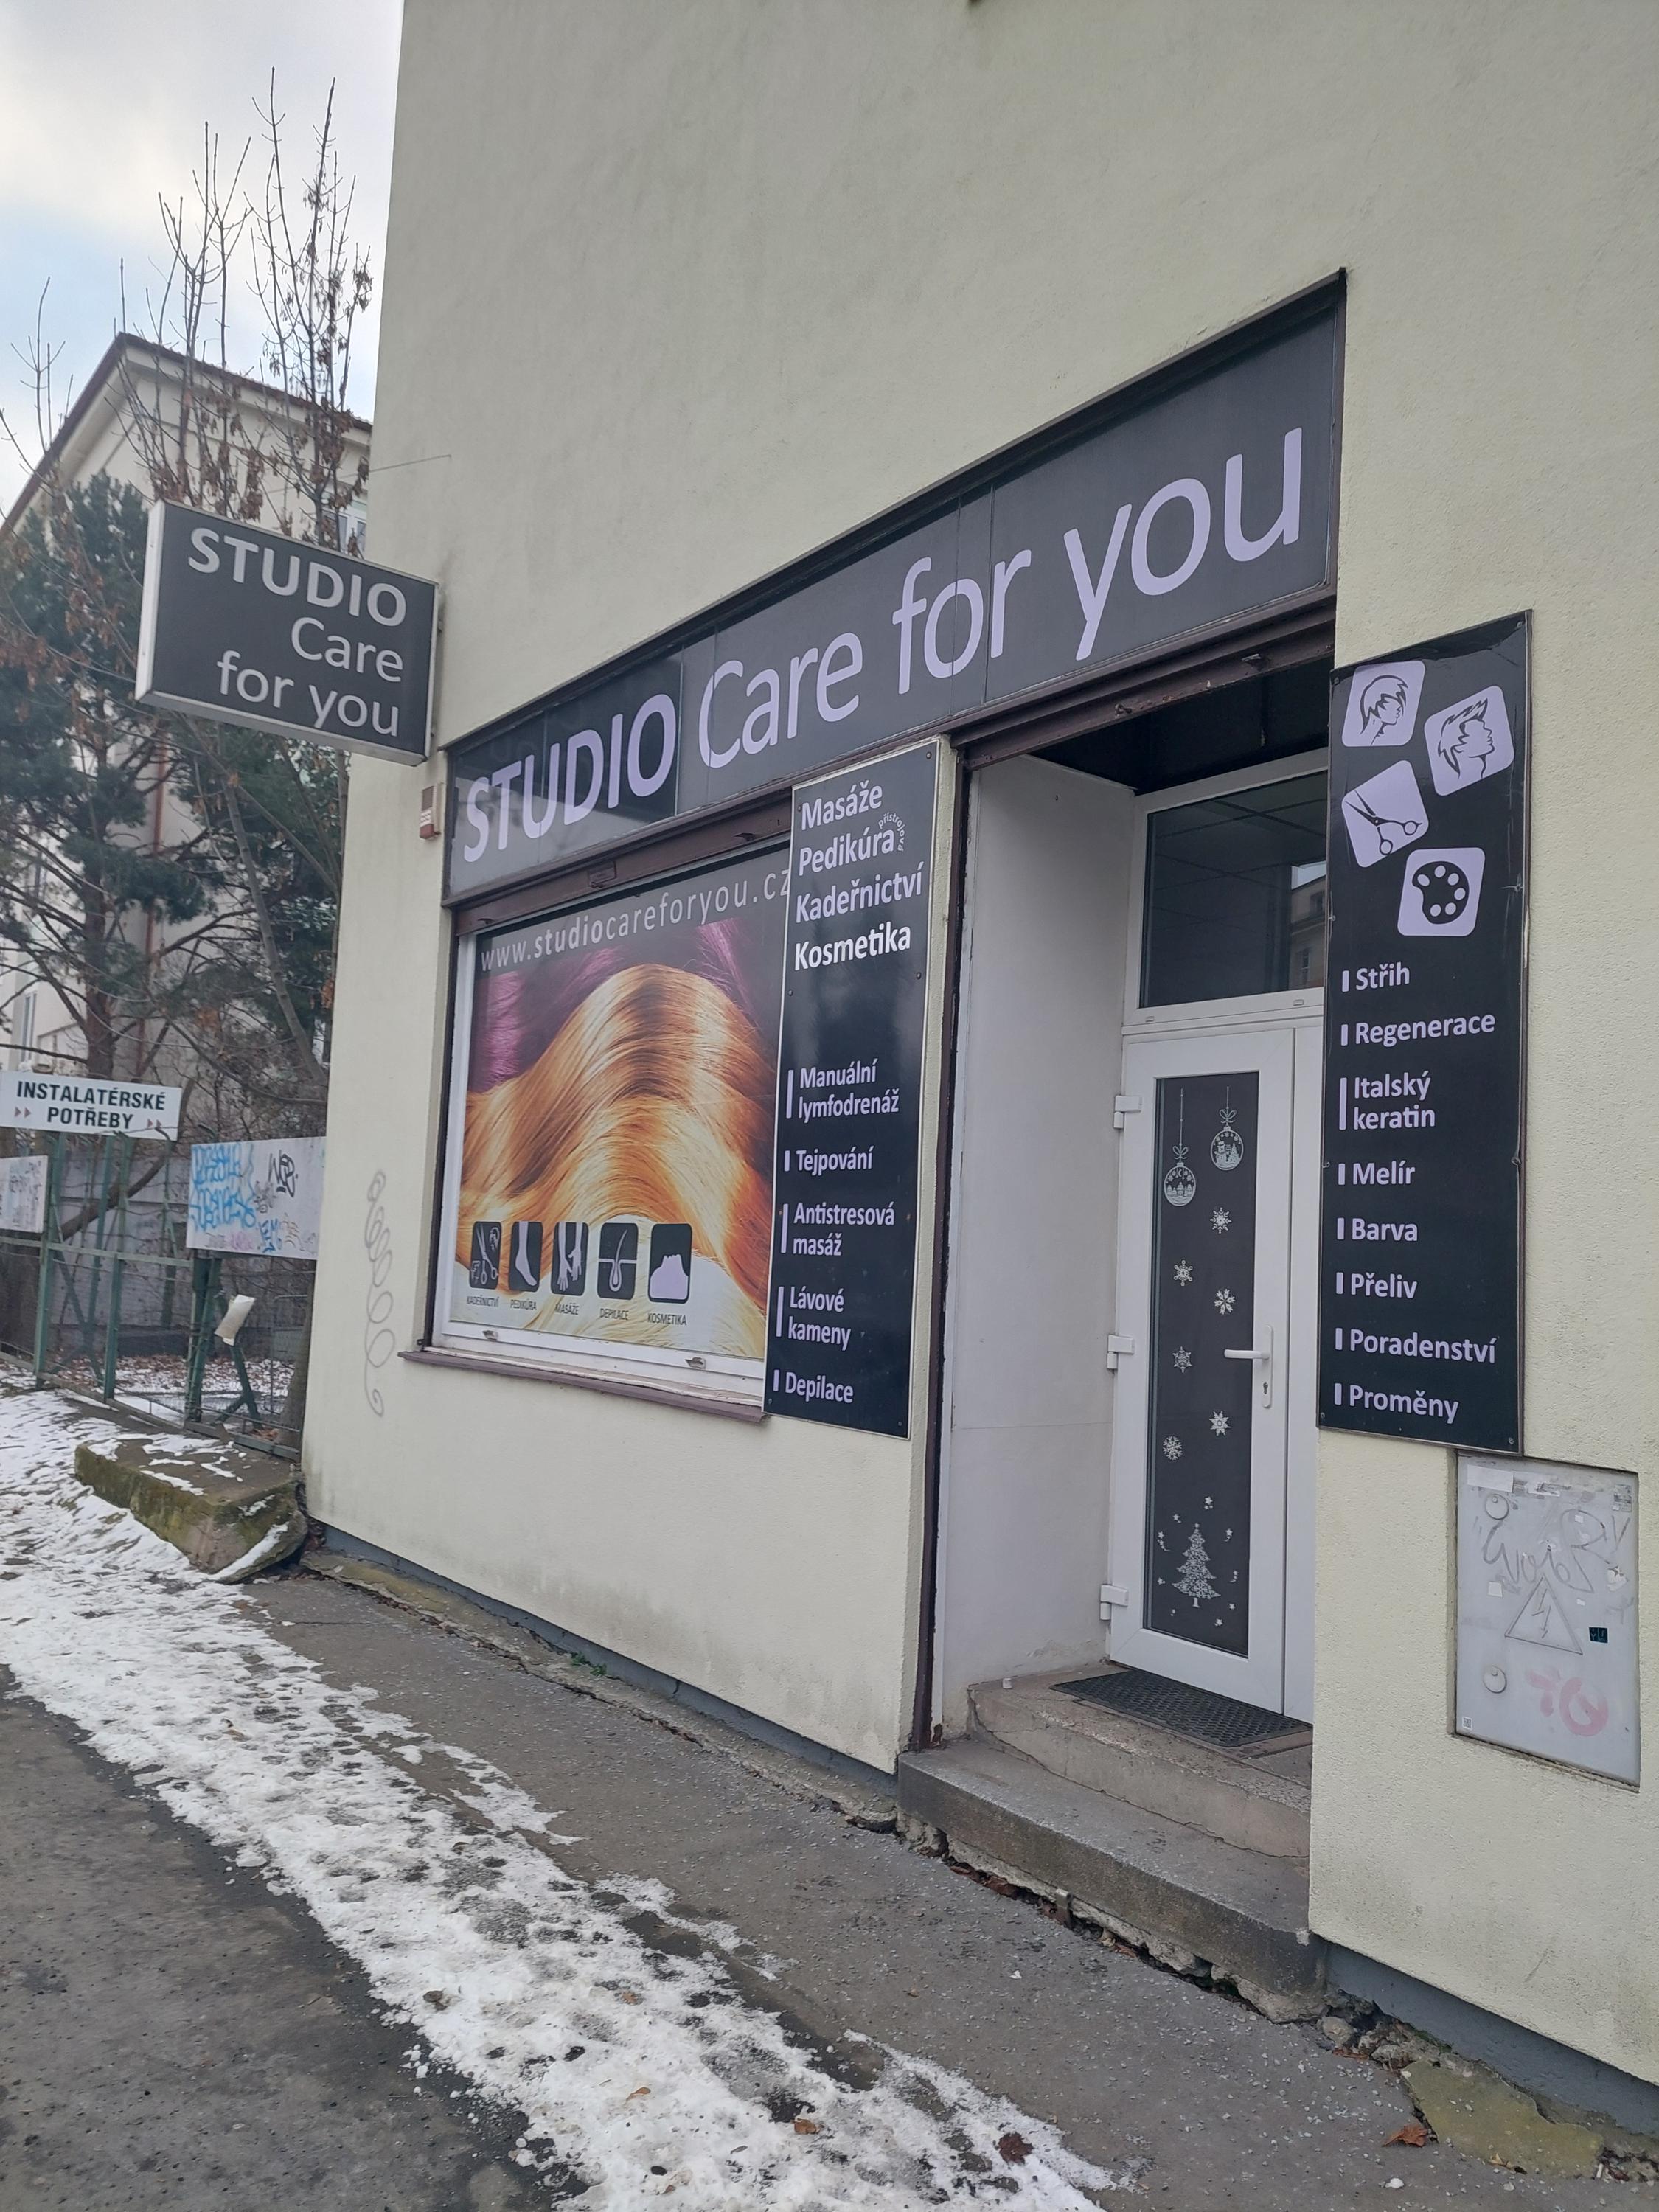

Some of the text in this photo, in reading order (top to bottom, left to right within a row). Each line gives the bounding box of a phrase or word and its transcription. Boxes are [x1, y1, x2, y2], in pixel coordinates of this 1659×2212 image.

[188, 528, 407, 627] STUDIO
[291, 616, 403, 682] Care
[464, 427, 1302, 863] STUDIO Care for you
[217, 650, 399, 736] for you
[801, 780, 883, 831] Masáže
[799, 827, 894, 876] Pedikúra
[796, 861, 924, 923] Kadeřnictví
[481, 869, 790, 972] www.studiocareforyou.cz
[794, 921, 911, 971] Kosmetika
[1355, 961, 1410, 991] Střih
[1355, 1014, 1495, 1047] Regenerace
[800, 1057, 878, 1089] Manuální
[1354, 1071, 1431, 1101] Italský
[17, 1081, 166, 1110] INSTALATÉRSKÉ
[798, 1088, 900, 1124] lymfodrenáž
[46, 1105, 133, 1130] POTŘEBY
[1353, 1105, 1436, 1130] keratin
[796, 1146, 874, 1176] Tejpování
[1352, 1160, 1416, 1186] Melír
[793, 1202, 895, 1226] Antistresová
[1352, 1217, 1418, 1242] Barva
[793, 1233, 843, 1256] masáž
[790, 1286, 844, 1312] Lávové
[1351, 1272, 1418, 1299] Přeliv
[599, 1307, 630, 1321] DEPILACE
[647, 1312, 687, 1326] KOSMETIKA
[787, 1316, 852, 1351] kameny
[1350, 1329, 1497, 1363] Poradenství
[785, 1371, 854, 1404] Depilace
[1349, 1384, 1459, 1424] Proměny
